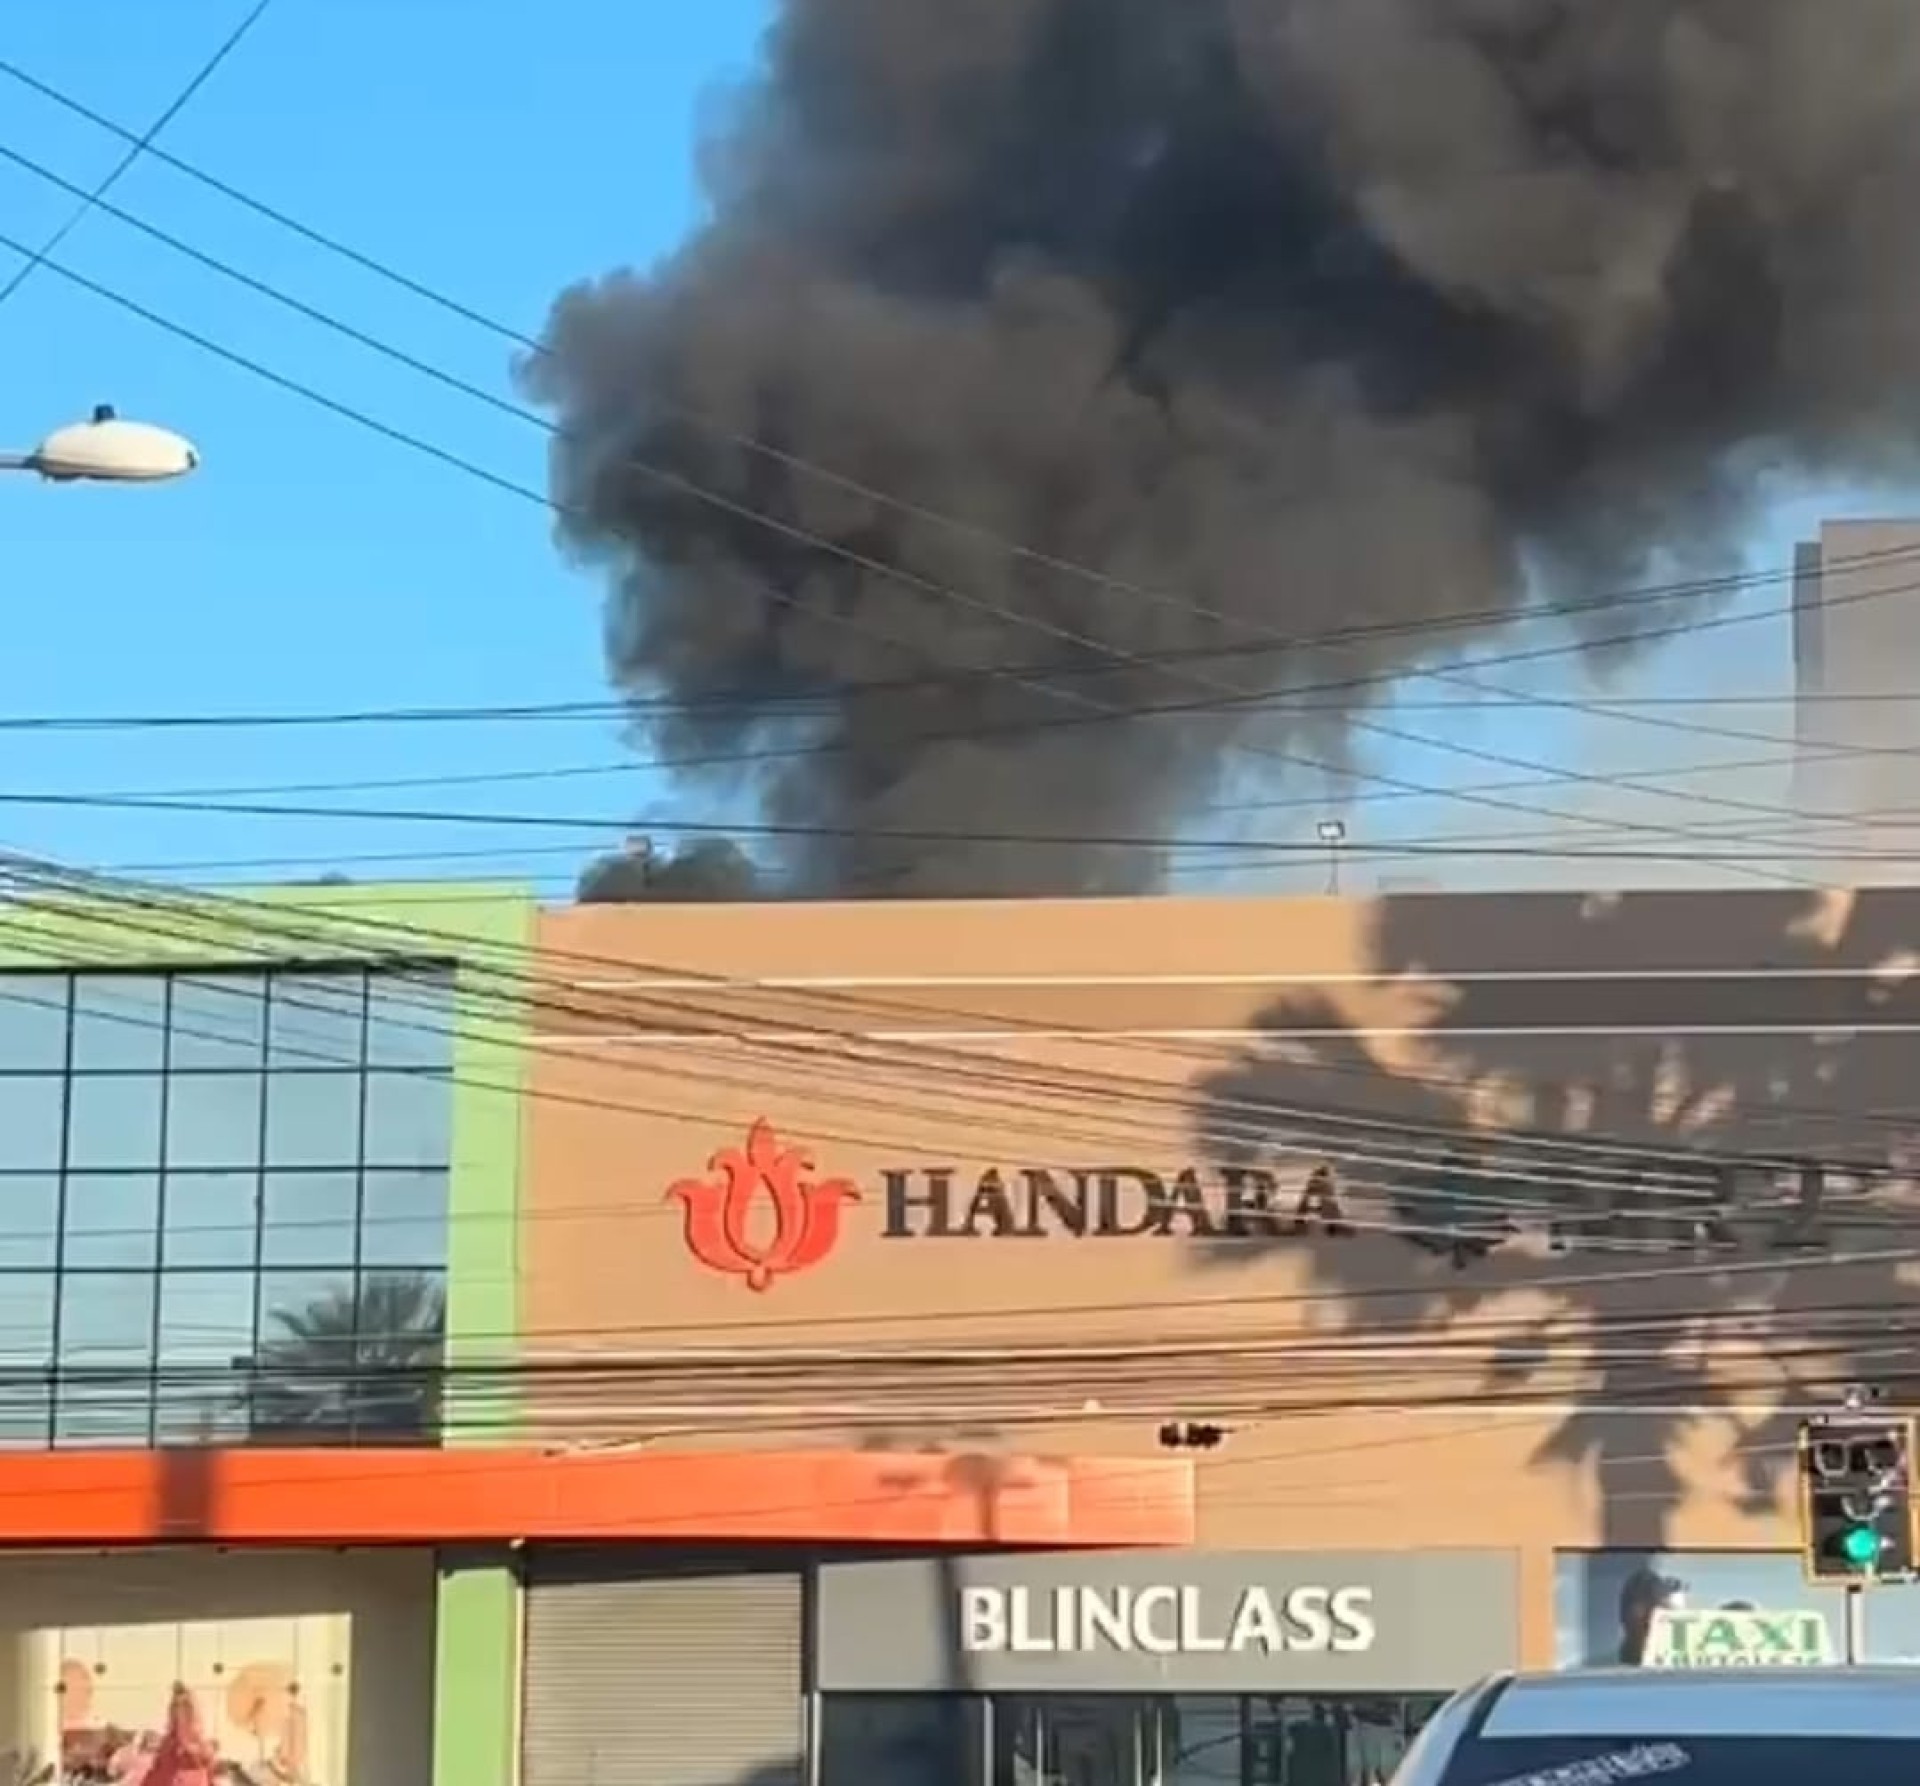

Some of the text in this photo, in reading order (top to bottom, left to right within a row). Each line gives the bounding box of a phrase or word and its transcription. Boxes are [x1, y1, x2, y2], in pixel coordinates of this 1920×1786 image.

[880, 1167, 1352, 1238] HANDARA
[960, 1586, 1376, 1653] BLINCLASS
[1658, 1615, 1821, 1651] TAXI
